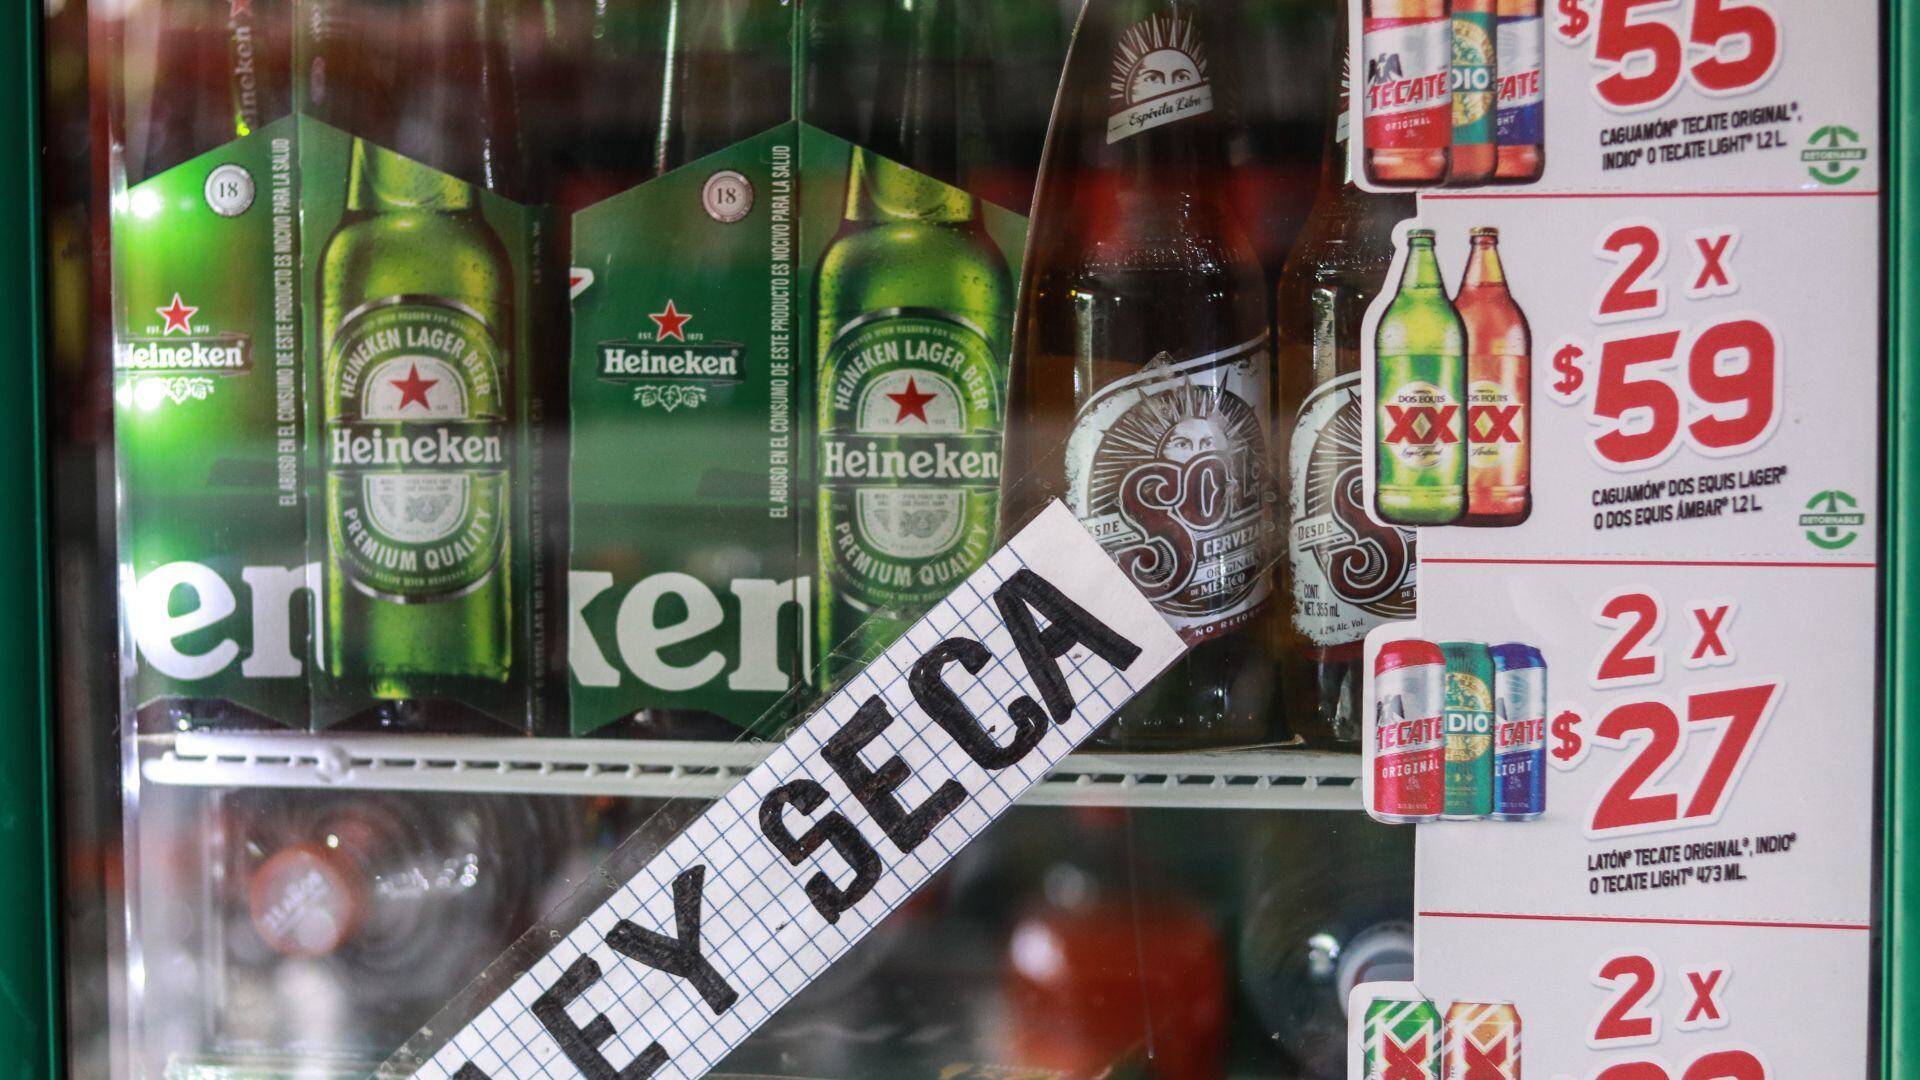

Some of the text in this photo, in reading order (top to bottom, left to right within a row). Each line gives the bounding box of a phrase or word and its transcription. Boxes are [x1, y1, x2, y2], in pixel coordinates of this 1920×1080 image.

[1367, 71, 1448, 110] TECATE
[1681, 113, 1728, 134] TECATE
[1659, 140, 1706, 162] TECATE
[220, 182, 238, 198] 18
[717, 187, 736, 204] 18
[1600, 226, 1660, 314] 2
[272, 138, 297, 506] EL ABUSO EN EL CONSUMO DE ESTE PRODUCTO ES NOCIVO PARA LA SALUD
[769, 145, 790, 518] EL ABUSO EN EL CONSUMO DE ESTE PRODUCTO ES NOCIVO PARA LA SALUD
[340, 327, 402, 398] HEINEKEN
[407, 326, 466, 358] LAGER
[463, 350, 491, 396] BEER
[834, 340, 900, 412] HEINEKEN
[905, 339, 966, 372] LAGER
[962, 363, 990, 412] BEER
[1398, 395, 1417, 403] DOS
[1384, 404, 1460, 444] XX
[331, 428, 503, 464] Heineken
[823, 441, 1000, 479] Heineken
[1668, 477, 1694, 496] DOS
[1698, 472, 1735, 494] EQUIS
[1297, 521, 1333, 540] DESDE
[1606, 508, 1632, 528] DOS
[1635, 504, 1673, 525] EQUIS
[1802, 515, 1860, 525] RETORNABLE
[344, 507, 418, 571] PREMIUM
[424, 506, 492, 571] QUALITY
[835, 521, 913, 587] PREMIUM
[918, 523, 989, 587] QUALITY
[1207, 554, 1257, 579] ORGINAL
[1195, 626, 1214, 637] NO
[1597, 592, 1658, 680] 2
[1377, 716, 1443, 752] TECATE
[1445, 713, 1489, 732] DIO
[1382, 758, 1440, 779] ORIGINAL
[452, 568, 1143, 1080] EY SECA
[1634, 845, 1681, 866] TECATE
[1601, 872, 1648, 892] TECATE
[1697, 864, 1722, 883] 473
[1595, 955, 1655, 1040] 2
